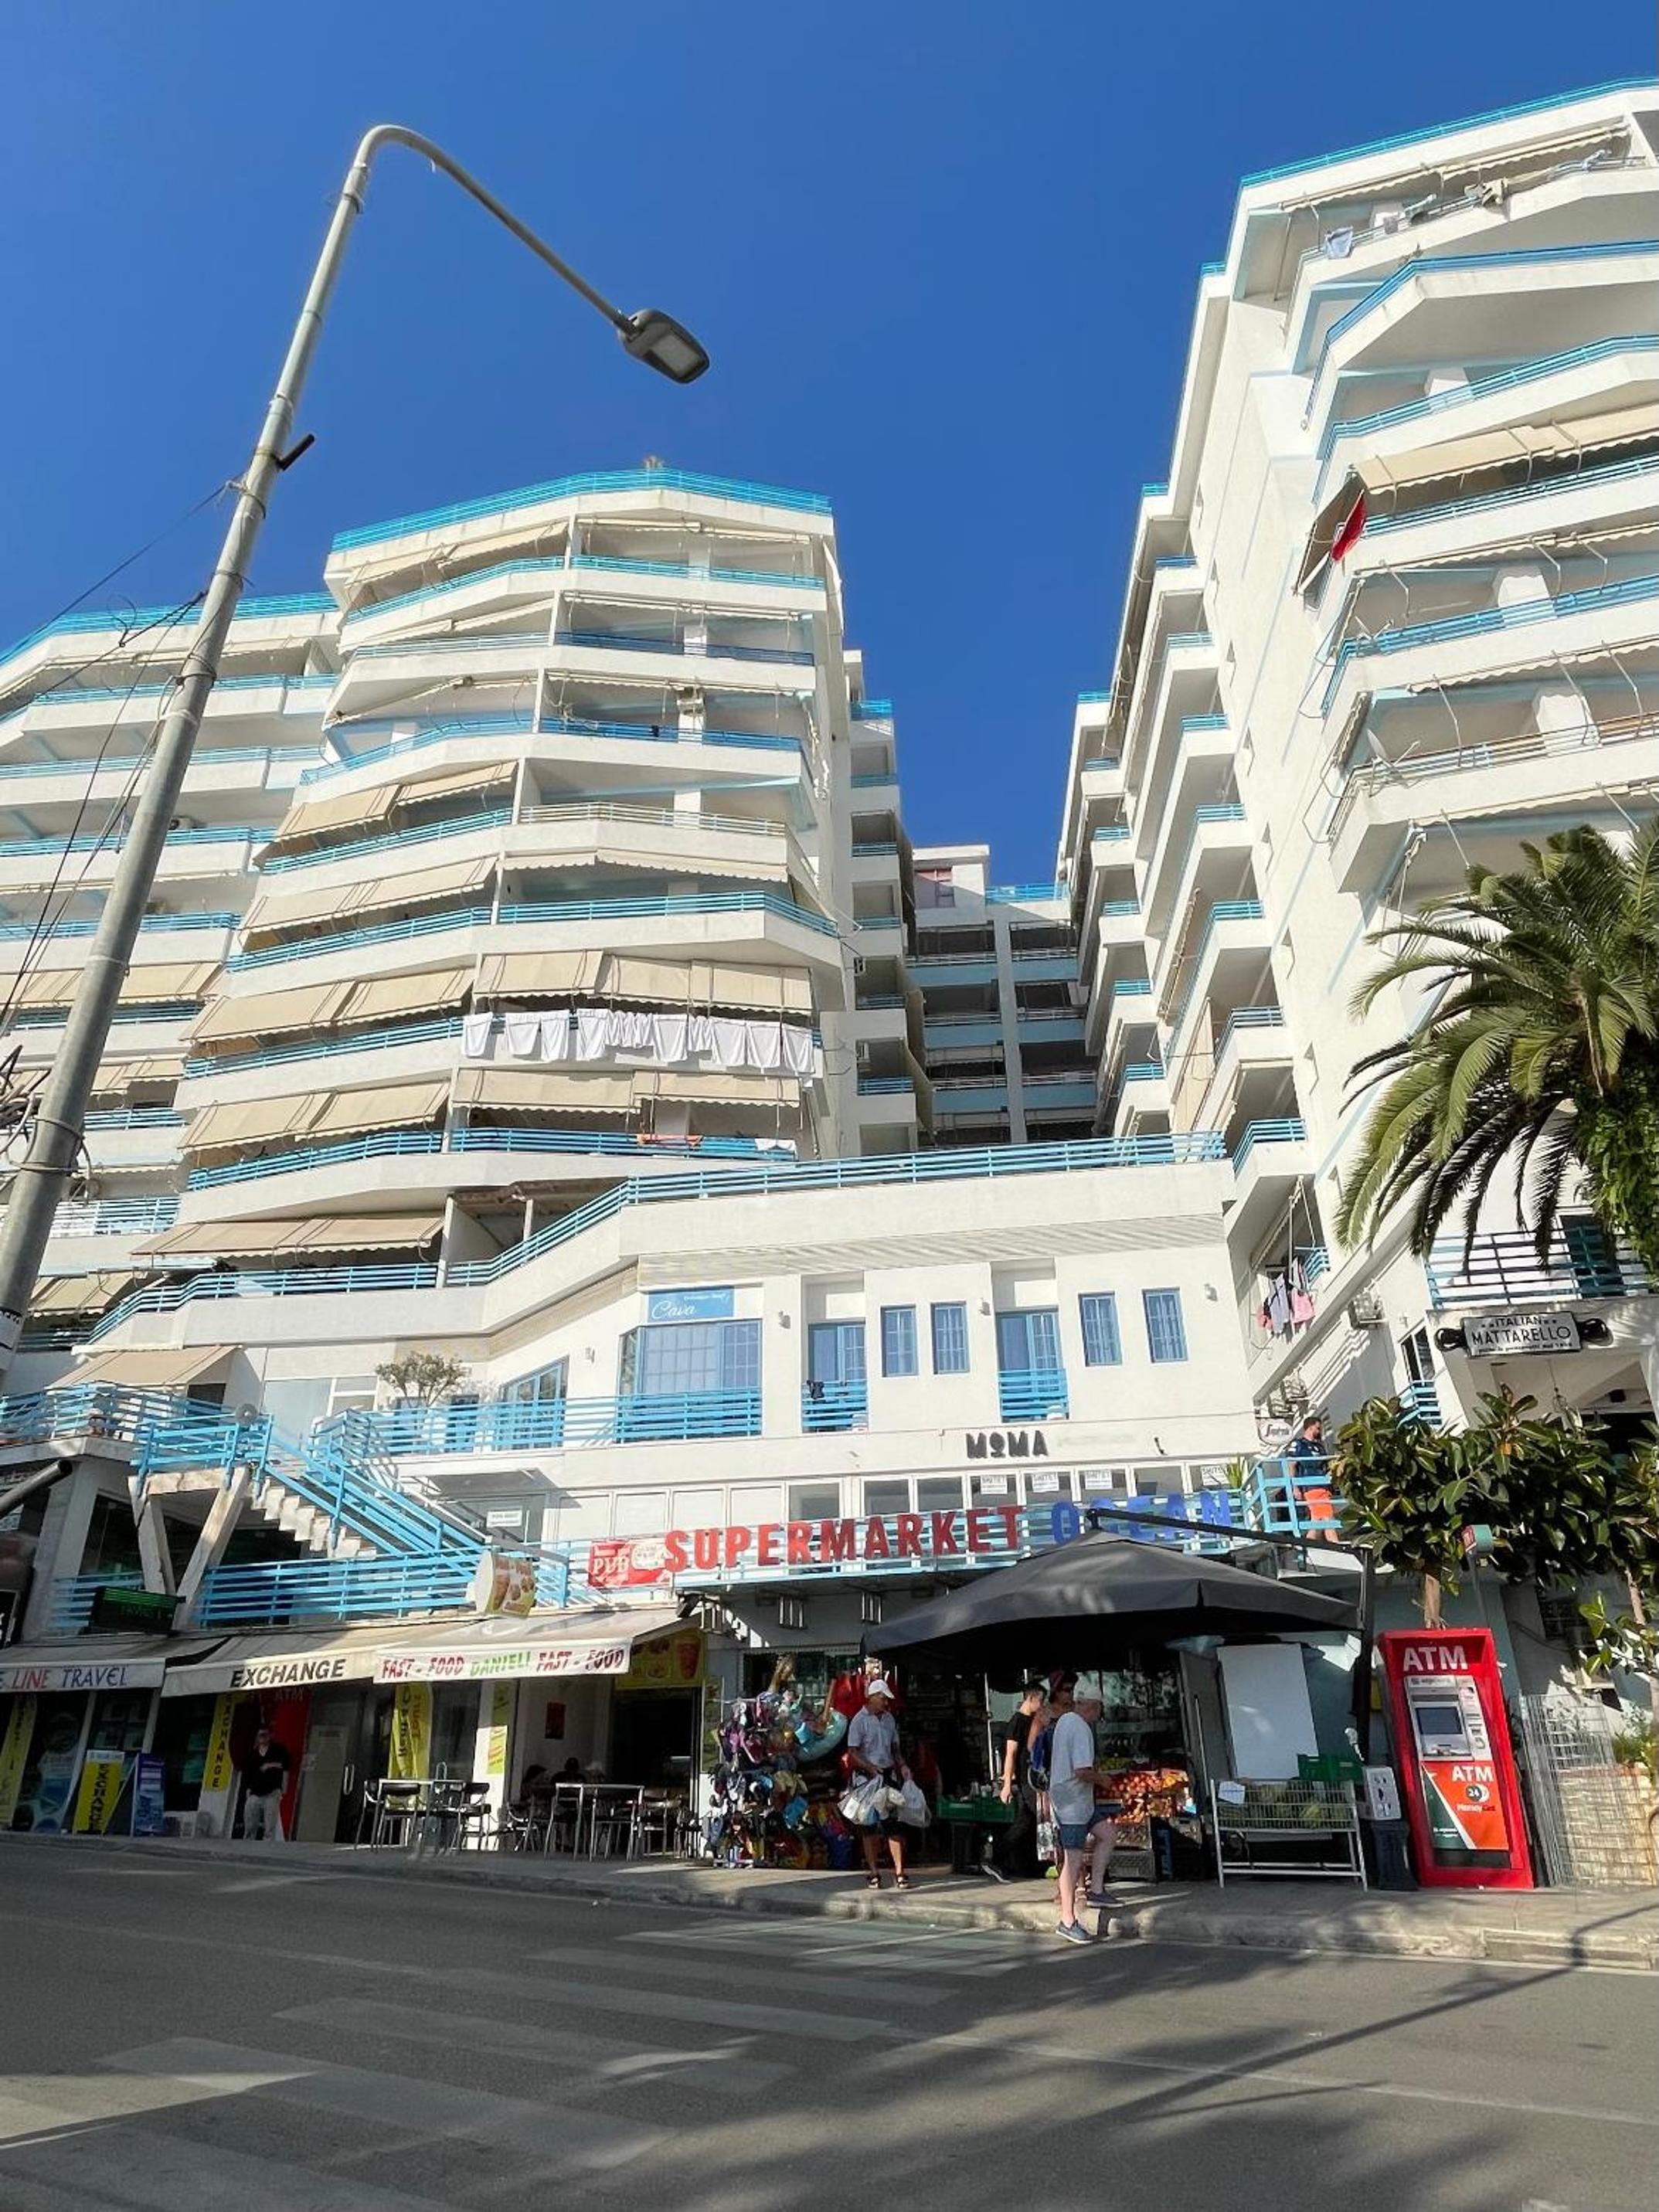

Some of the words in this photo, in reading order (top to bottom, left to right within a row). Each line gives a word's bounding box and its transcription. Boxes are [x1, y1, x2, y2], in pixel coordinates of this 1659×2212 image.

[1495, 1317, 1542, 1327] ITALIAN
[1471, 1326, 1571, 1345] MATTARELLO
[966, 1430, 1049, 1459] MOMA
[665, 1505, 1025, 1572] SUPERMARKET
[382, 1658, 415, 1679] FAST
[426, 1656, 465, 1677] FOOD
[535, 1650, 573, 1671] FAST
[585, 1647, 624, 1670] FOOD
[1403, 1645, 1468, 1671] ATM
[12, 1670, 53, 1689] LINE
[62, 1666, 128, 1688] TRAVEL
[230, 1659, 346, 1688] EXCHANGE
[1453, 1765, 1494, 1782] ATM
[1468, 1788, 1481, 1797] 24
